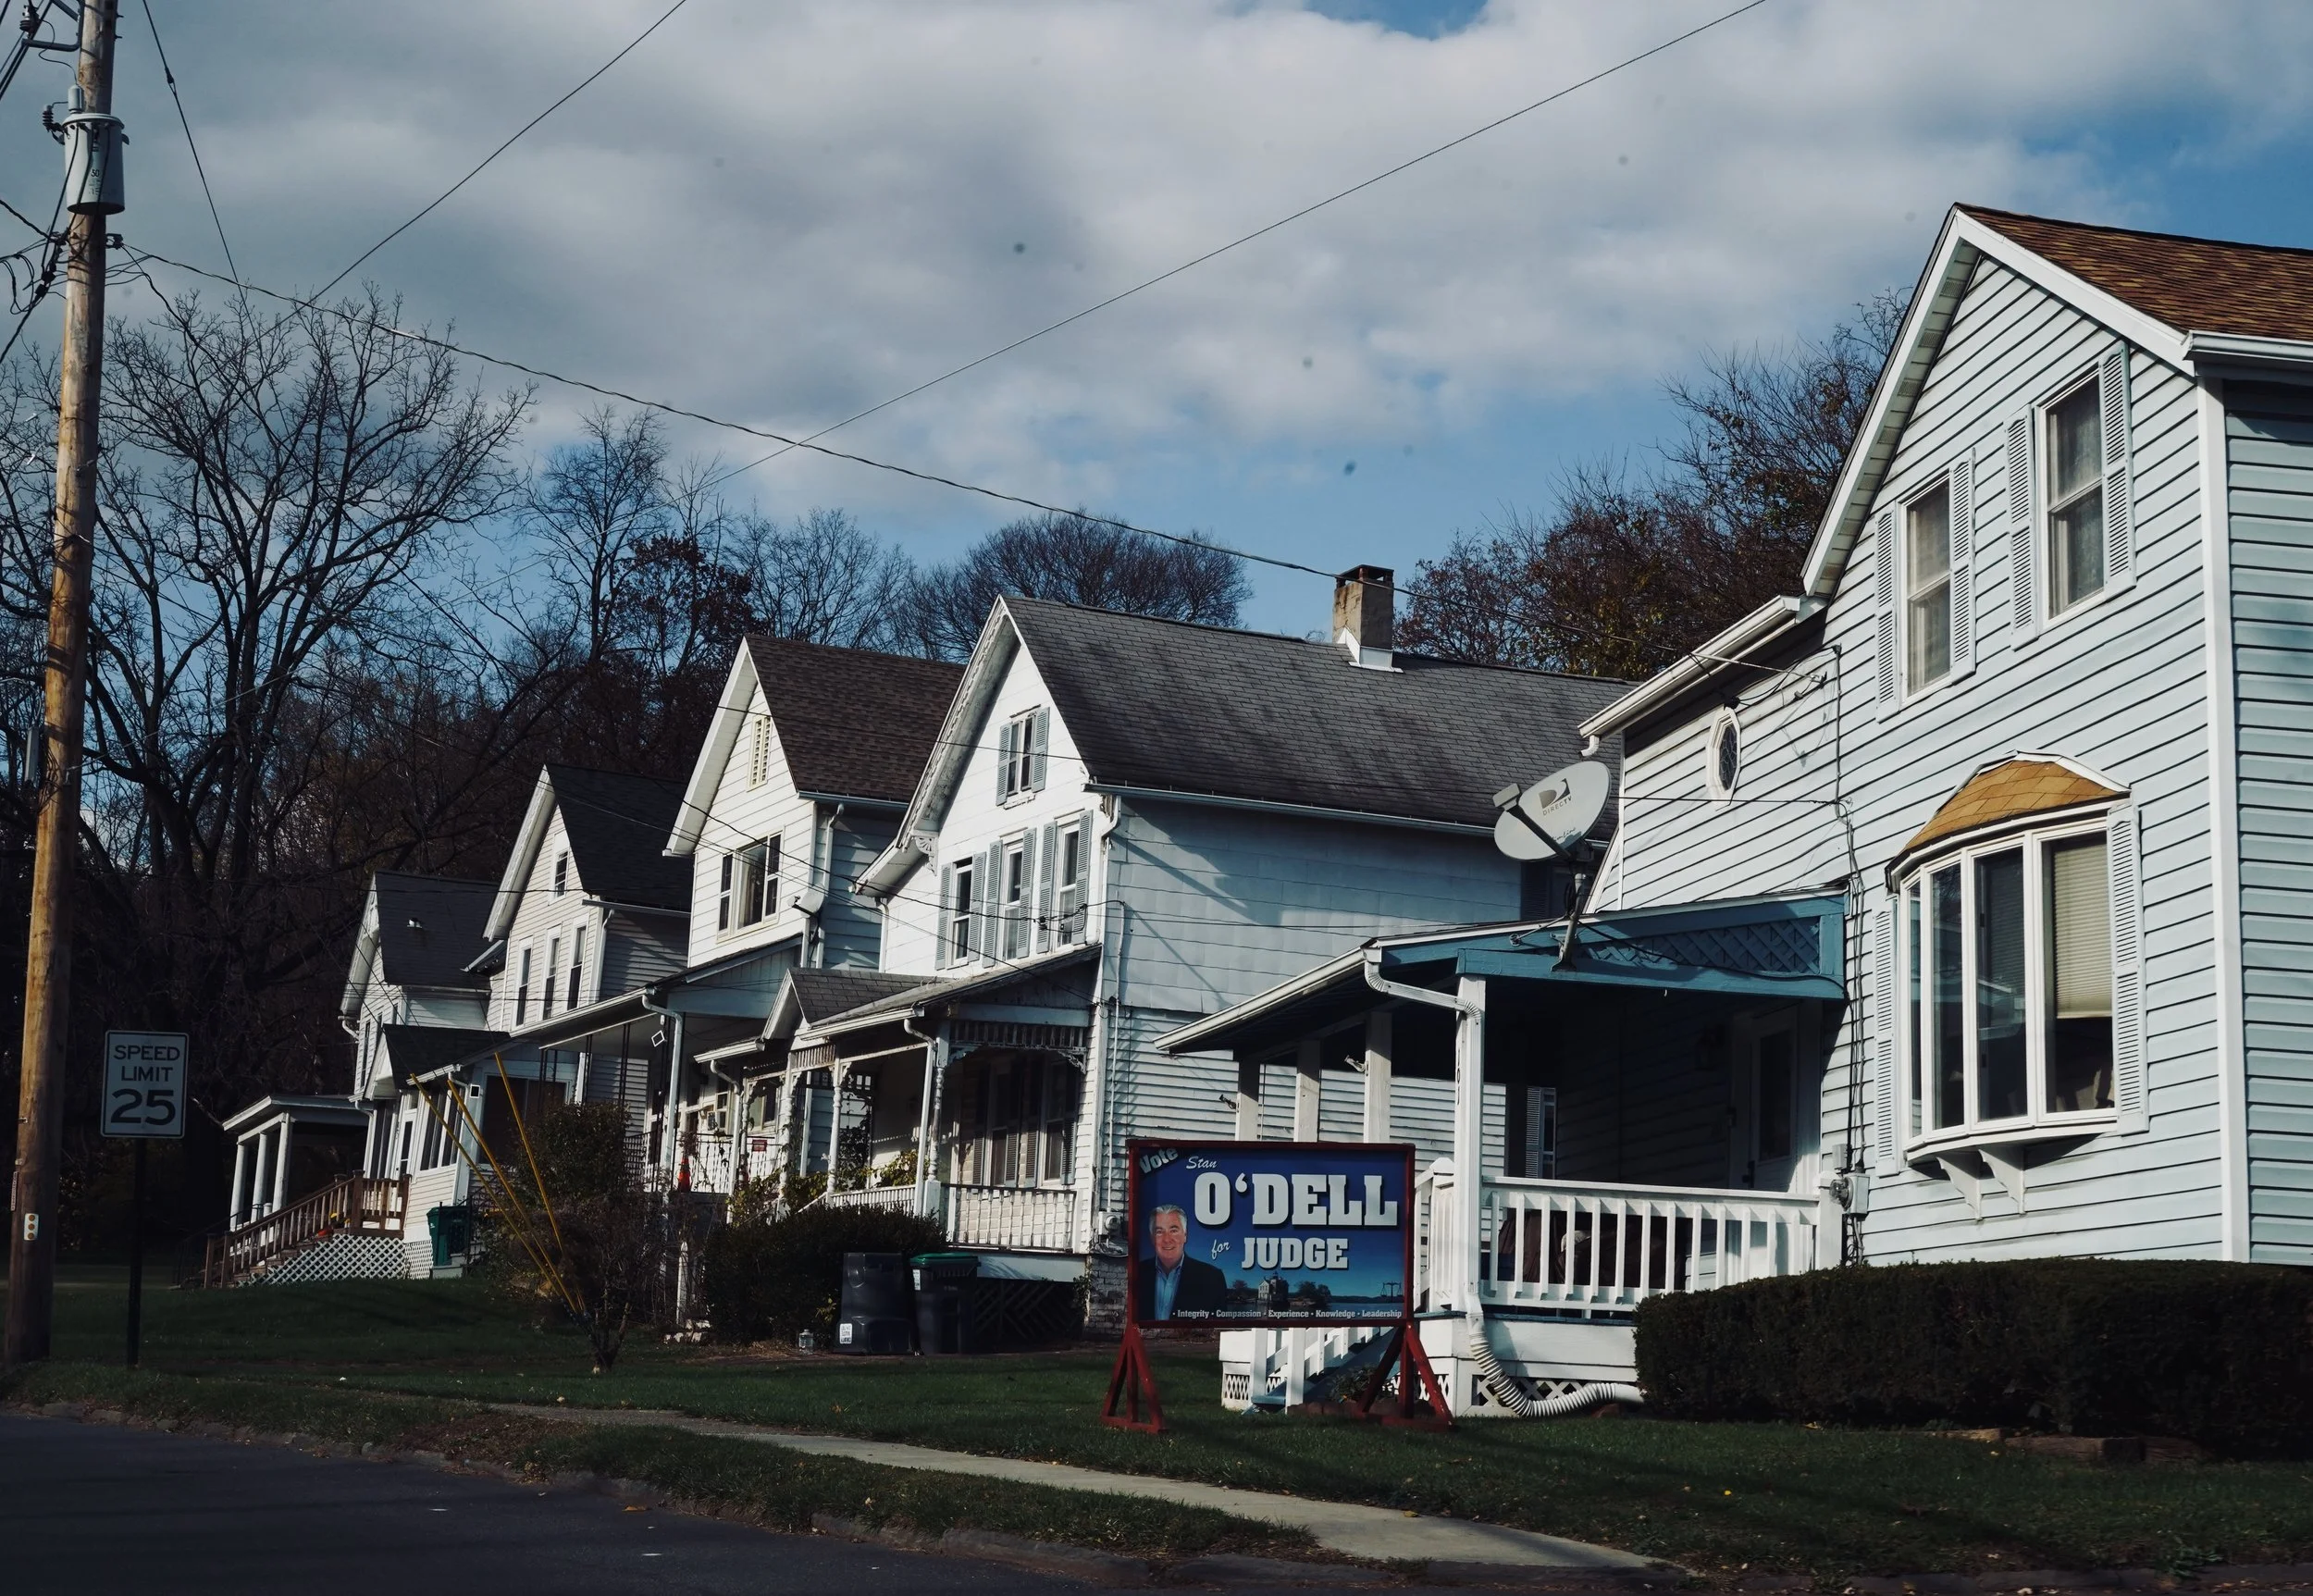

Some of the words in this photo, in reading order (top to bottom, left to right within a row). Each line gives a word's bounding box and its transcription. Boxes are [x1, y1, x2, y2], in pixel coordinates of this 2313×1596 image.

[1542, 796, 1572, 816] DIRECTV
[114, 1045, 180, 1061] SPEED
[121, 1066, 174, 1082] LIMIT
[111, 1088, 177, 1126] 25
[1139, 1146, 1179, 1174] Vote
[1185, 1156, 1218, 1169] Stan
[1211, 1239, 1231, 1260] for
[1242, 1237, 1348, 1269] JUDGE
[1177, 1309, 1210, 1318] Integrity
[1216, 1309, 1262, 1319] Compassion
[1268, 1309, 1309, 1319] Experience
[1315, 1309, 1355, 1319] Knowledge
[1362, 1309, 1403, 1319] Leadership
